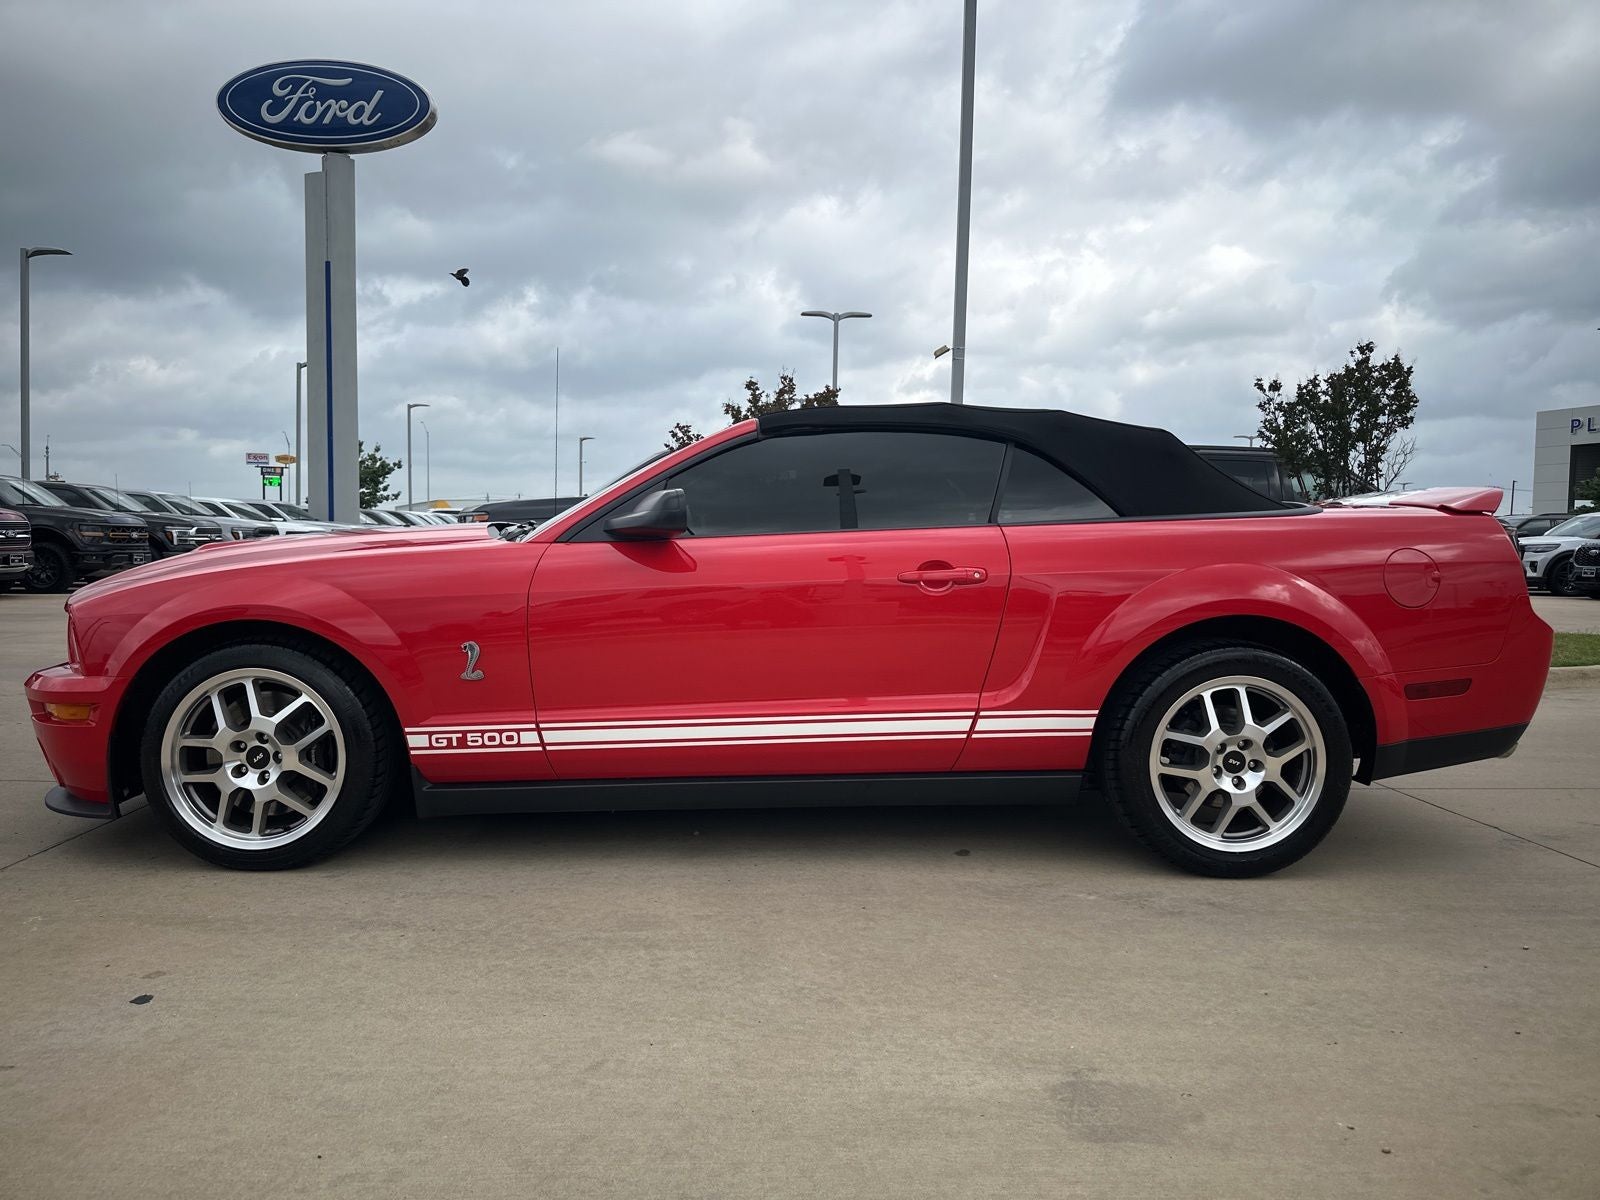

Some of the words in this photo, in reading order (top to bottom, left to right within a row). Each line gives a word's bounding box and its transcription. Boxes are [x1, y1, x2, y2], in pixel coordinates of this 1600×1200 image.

[260, 74, 384, 125] Ford
[247, 453, 268, 462] Exxon
[431, 733, 462, 747] GT
[466, 731, 519, 746] 500
[1228, 758, 1240, 766] SVT
